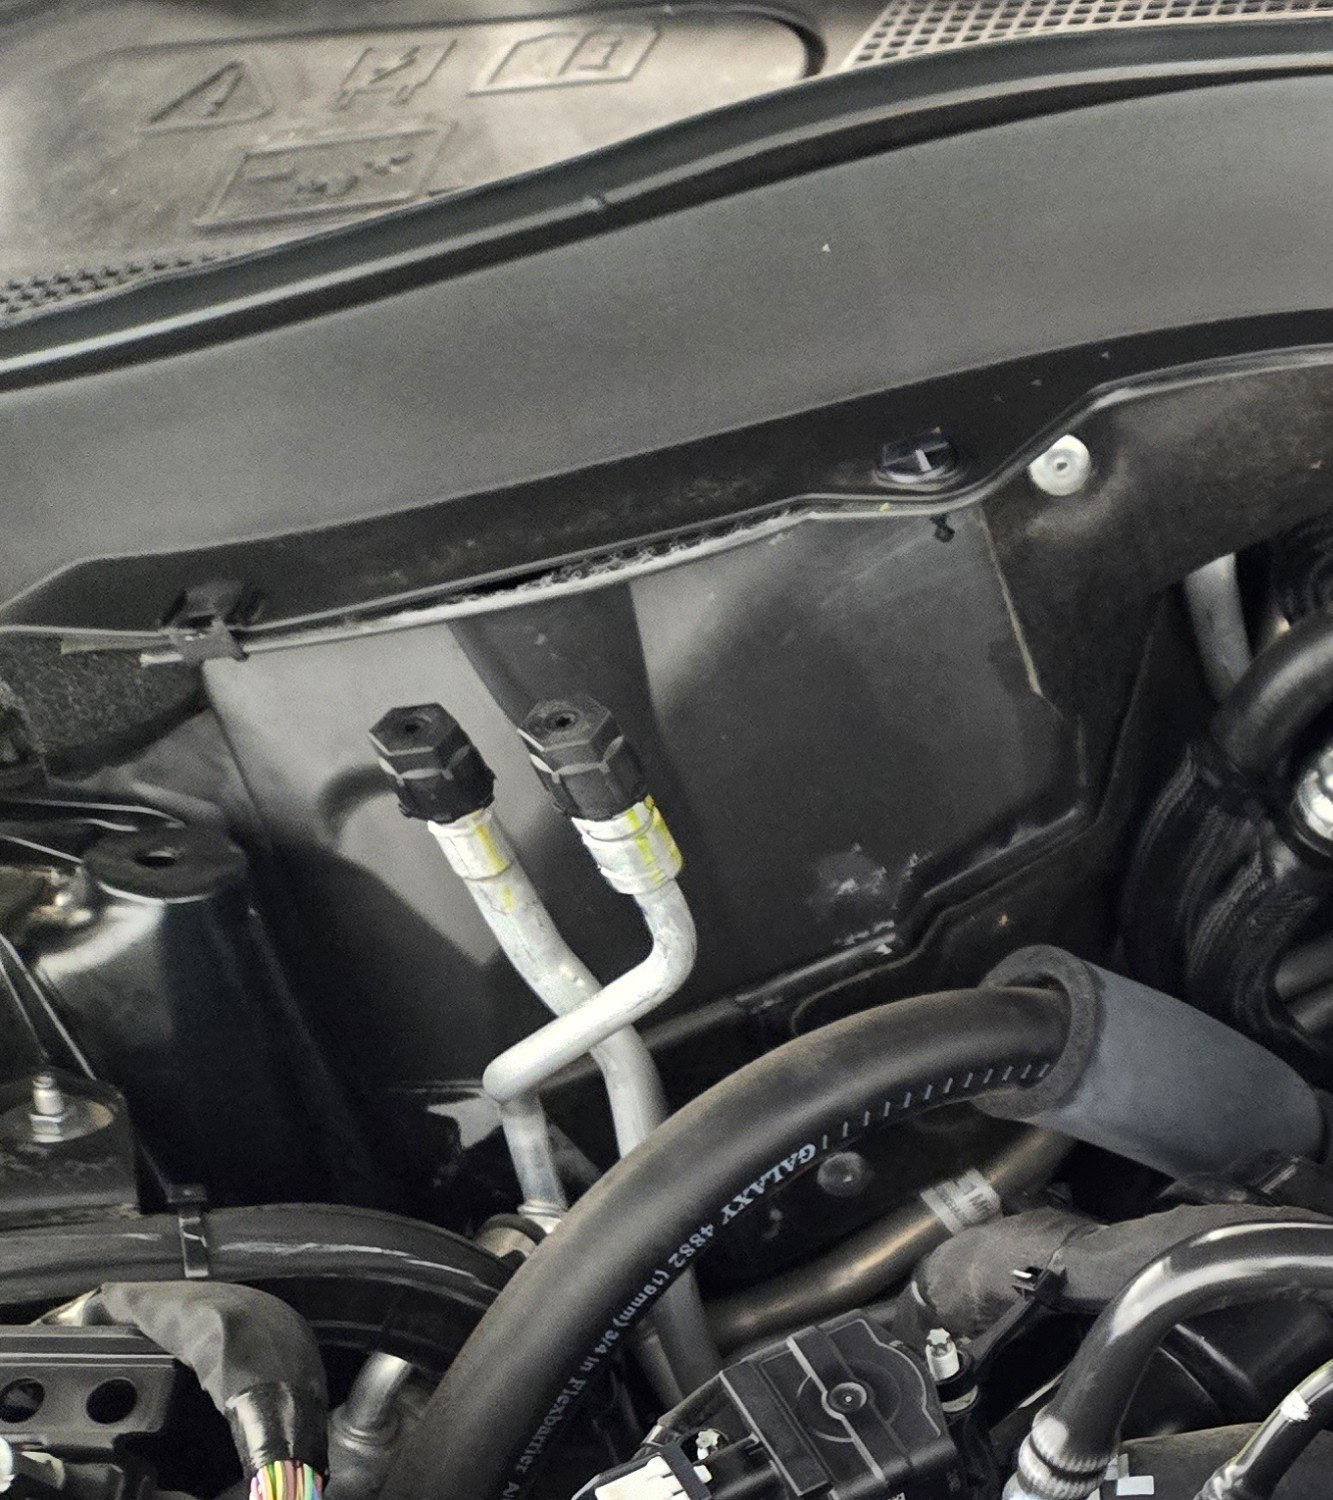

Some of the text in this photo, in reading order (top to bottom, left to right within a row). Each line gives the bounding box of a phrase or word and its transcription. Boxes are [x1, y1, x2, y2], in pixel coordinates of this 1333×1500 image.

[720, 1143, 816, 1226] GALAXY
[669, 1222, 716, 1270] 4882
[619, 1270, 670, 1328] (19mm)
[515, 1377, 586, 1474] Flexbarrier
